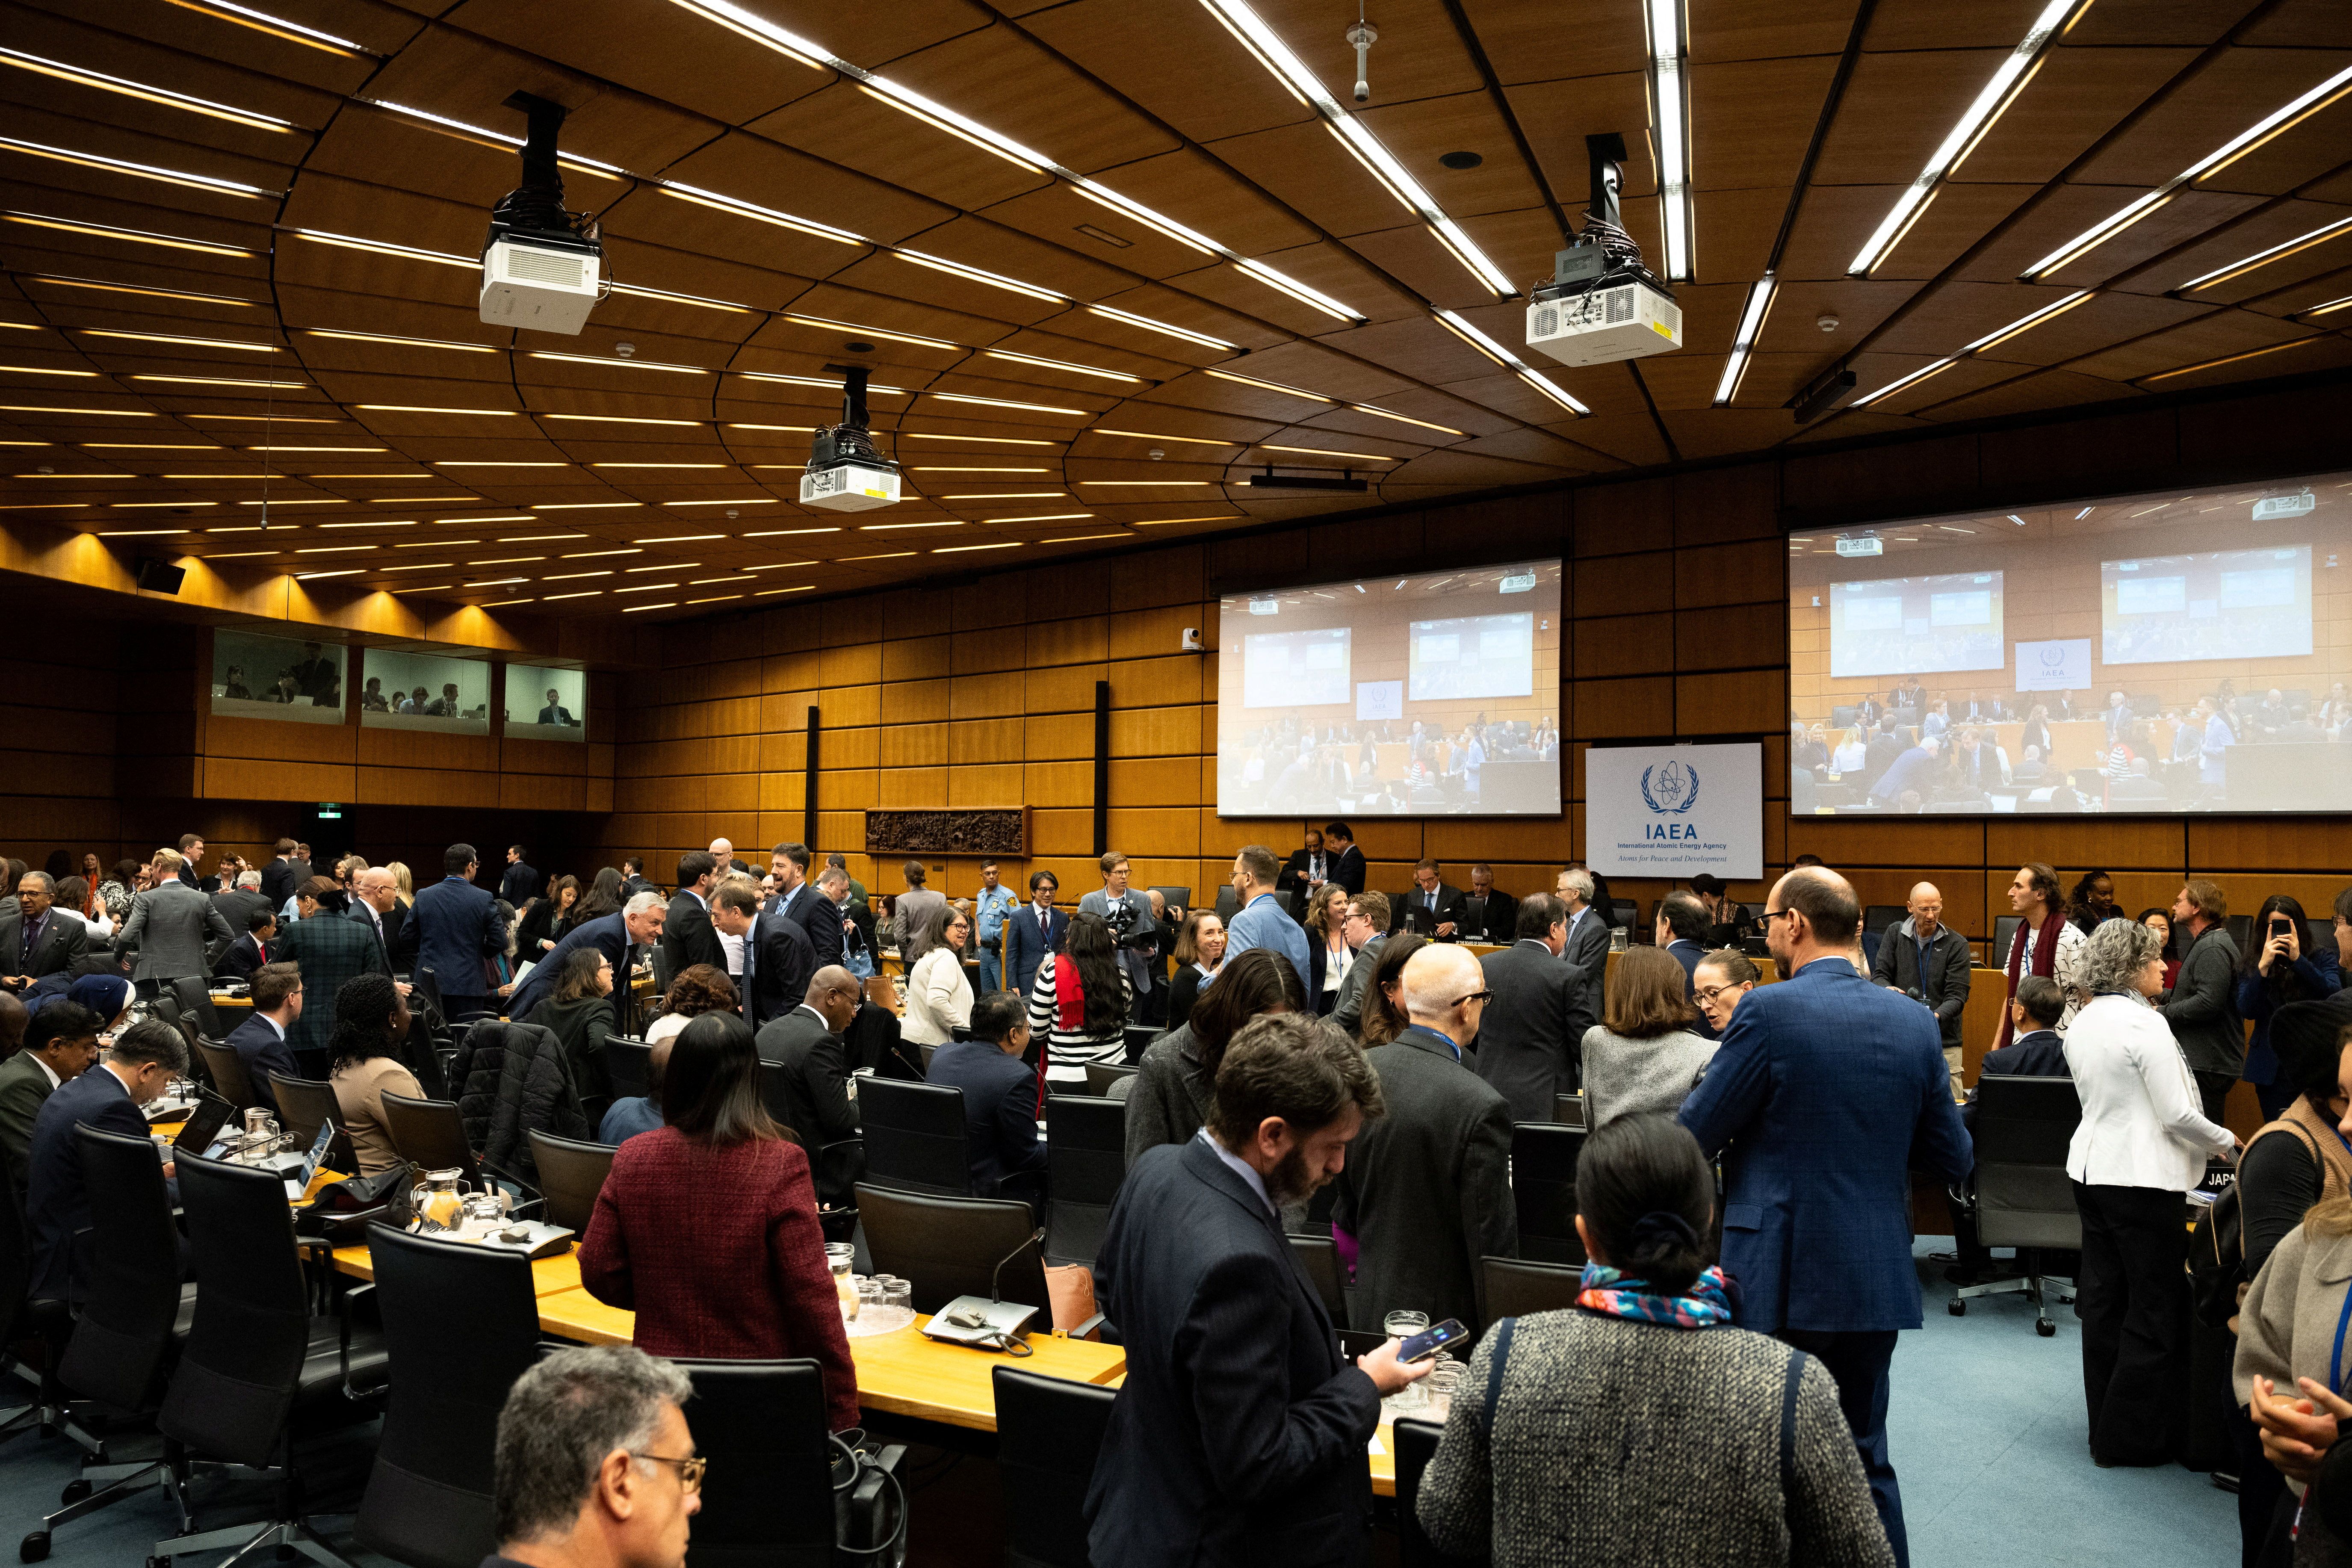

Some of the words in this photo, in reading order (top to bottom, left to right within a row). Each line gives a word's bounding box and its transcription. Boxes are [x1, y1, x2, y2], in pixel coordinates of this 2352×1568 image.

[1646, 824, 1698, 839] IAEA
[1637, 855, 1649, 863] for
[1684, 855, 1727, 864] Development
